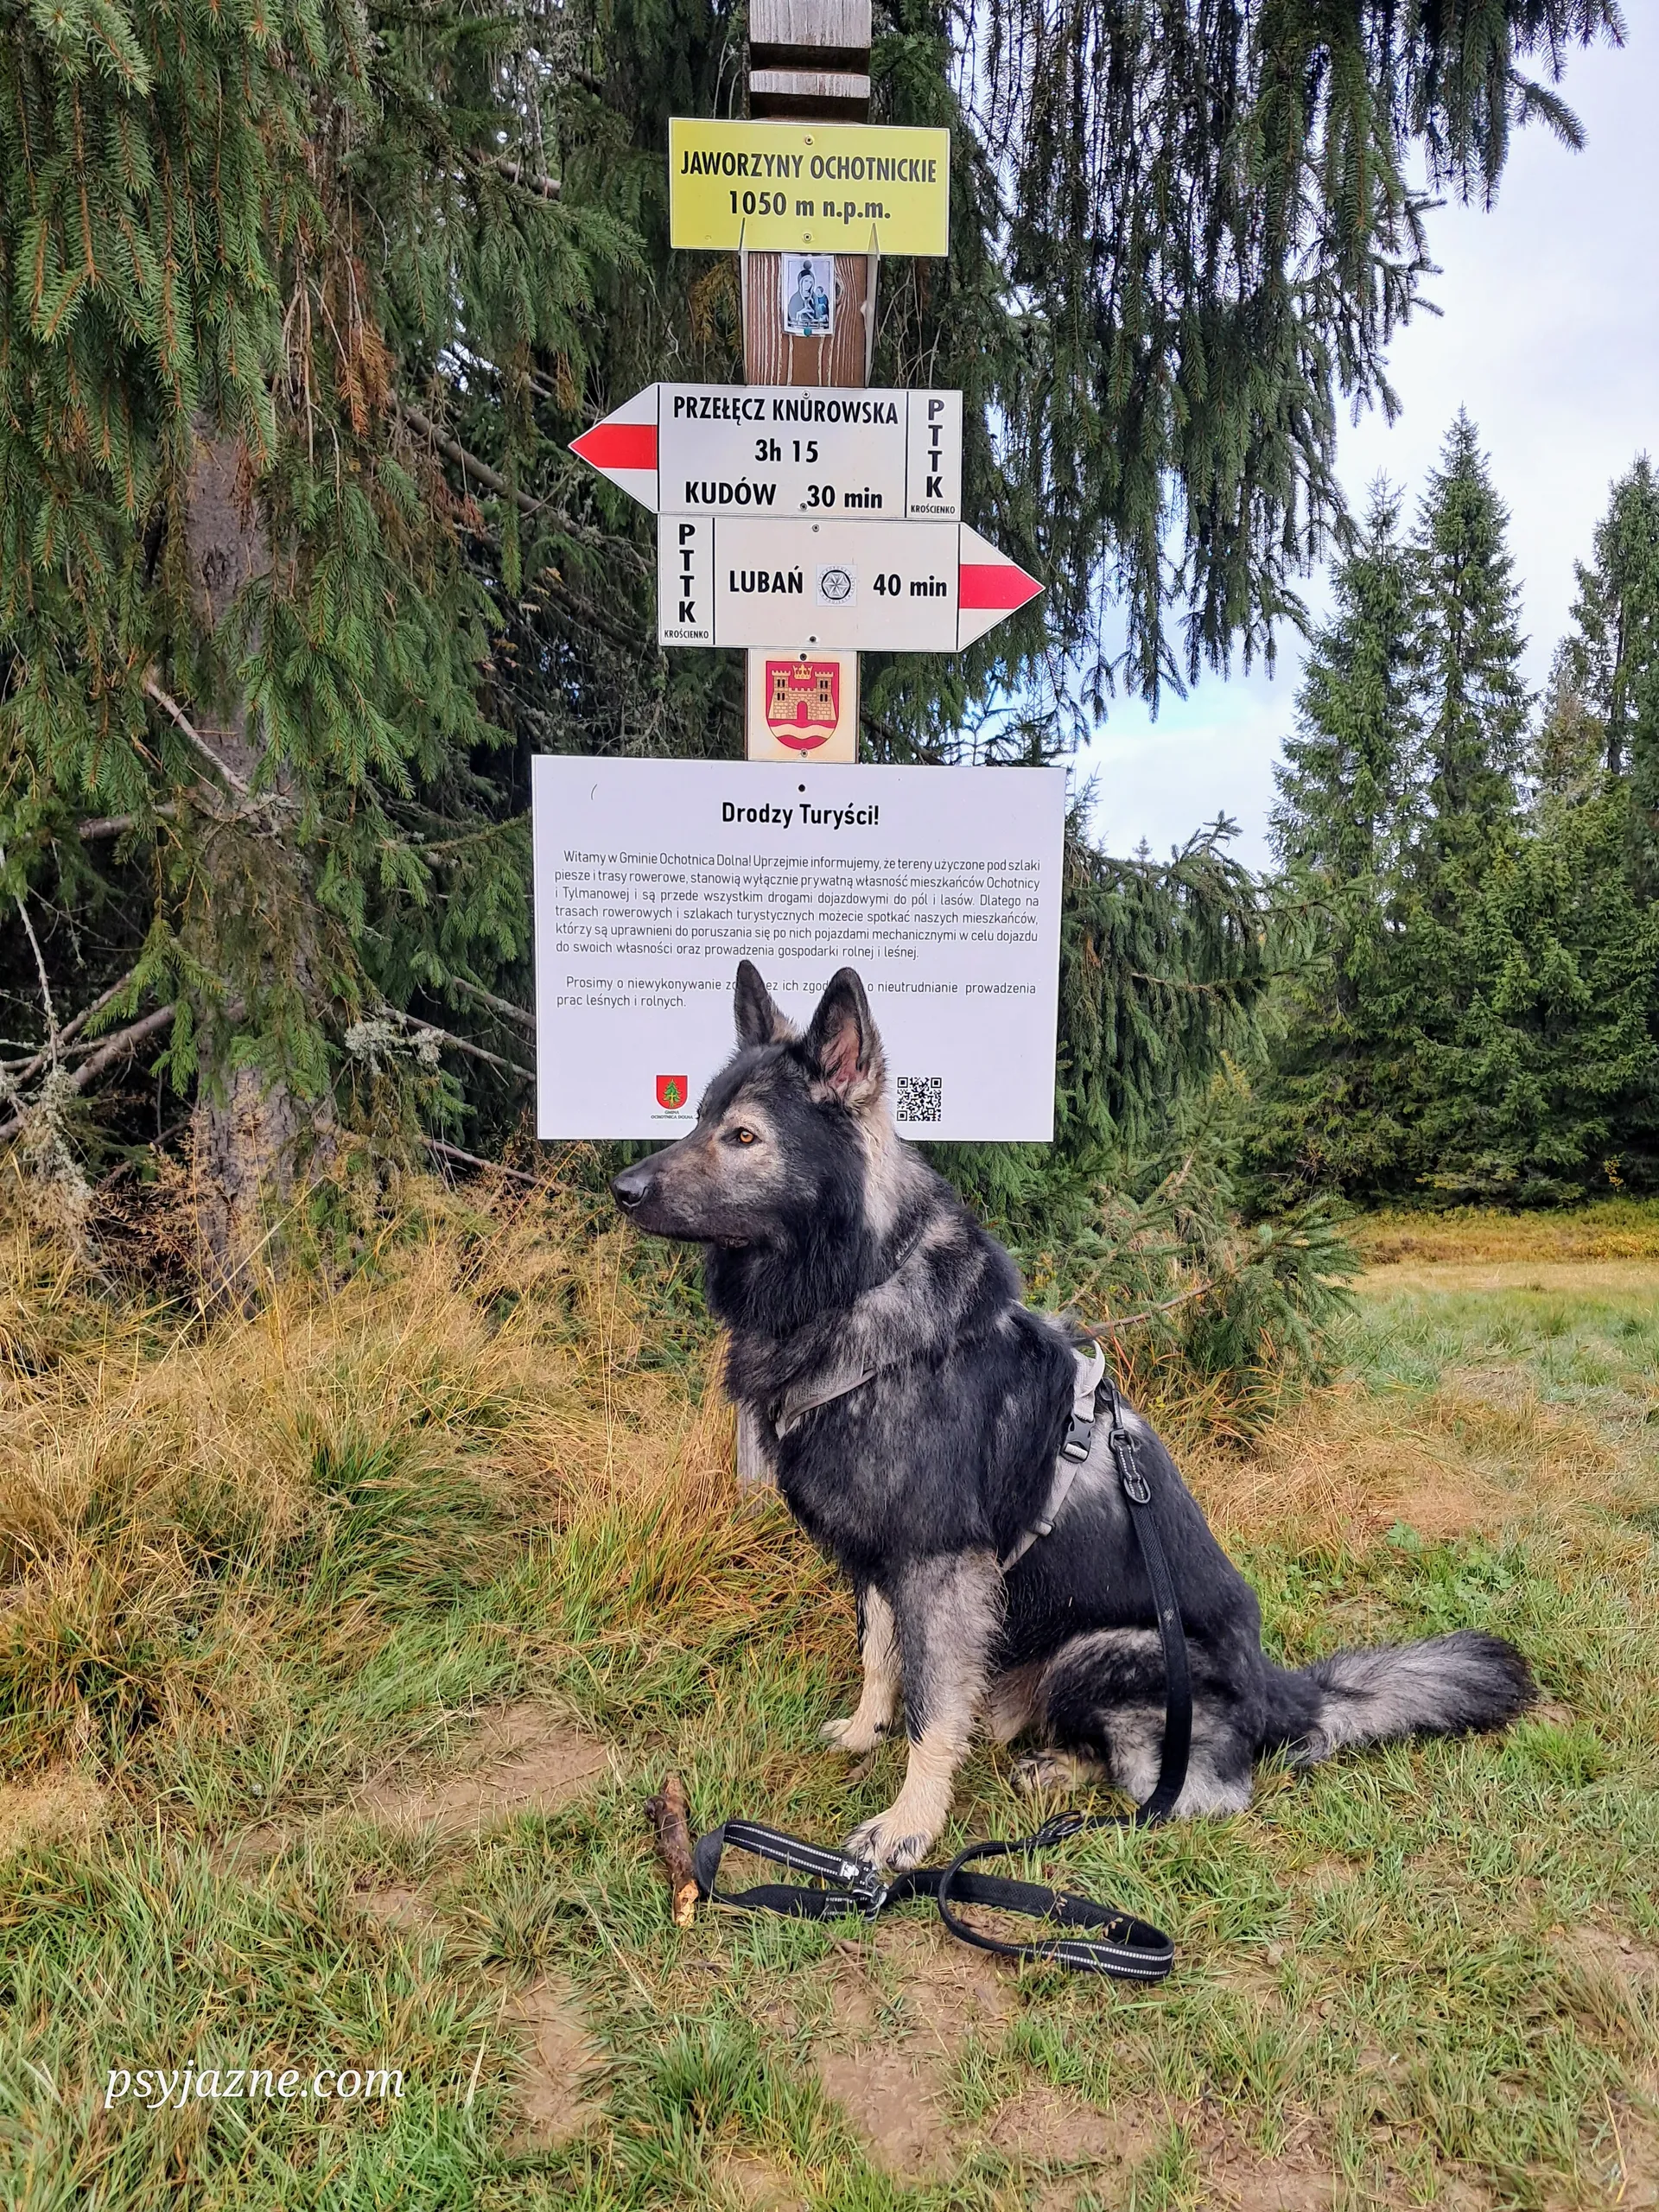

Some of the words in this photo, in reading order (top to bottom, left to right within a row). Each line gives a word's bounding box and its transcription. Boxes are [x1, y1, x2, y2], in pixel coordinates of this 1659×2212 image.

[680, 150, 804, 178] JAWORZYNY
[810, 155, 937, 183] OCHOTNICKIE
[729, 190, 787, 216] 1050
[796, 200, 815, 217] m
[823, 200, 891, 225] n.p.m.
[674, 396, 766, 426] PRZEŁĘCZ
[772, 399, 899, 424] KNUROWSKA
[754, 437, 782, 462] 3h
[792, 440, 818, 463] 15
[685, 476, 777, 505] KUDÓW
[807, 486, 835, 507] 30
[844, 486, 883, 509] min
[910, 505, 956, 514] KROŚCIENKO
[729, 565, 803, 594] LUBAŃ
[873, 573, 901, 597] 40
[910, 575, 947, 597] min
[664, 627, 709, 639] KROŚCIENKO
[722, 801, 794, 830] Drodzy
[798, 802, 879, 830] Turyści!
[563, 849, 607, 867] Witamy
[607, 854, 618, 863] w
[620, 851, 658, 865] Gminie
[659, 852, 715, 866] Ochotnica
[716, 854, 752, 867] Dolna!
[753, 855, 809, 871] Uprzejmie
[810, 855, 881, 872] informujemy,
[883, 860, 896, 869] że
[897, 858, 933, 873] tereny
[934, 861, 985, 874] użyczone
[987, 859, 1007, 874] pod
[1007, 859, 1040, 871] szlaki
[555, 871, 591, 883] piesze
[593, 872, 596, 881] i
[597, 869, 627, 885] trasy
[629, 873, 689, 885] rowerowe,
[690, 872, 741, 887] stanowią
[742, 873, 798, 888] wyłącznie
[800, 874, 854, 890] prywatną
[855, 874, 908, 887] własność
[910, 874, 985, 888] mieszkańców
[986, 876, 1040, 893] Ochotnicy
[555, 889, 558, 899] i
[562, 886, 630, 903] Tylmanowej
[634, 887, 638, 900] i
[642, 891, 656, 904] są
[660, 889, 699, 904] przede
[703, 890, 763, 905] wszystkim
[767, 891, 813, 906] drogami
[817, 892, 889, 907] dojazdowymi
[893, 893, 907, 905] do
[911, 892, 928, 908] pól
[932, 896, 936, 906] i
[940, 893, 974, 906] lasów.
[980, 893, 1021, 909] Dlatego
[1026, 897, 1039, 906] na
[555, 905, 599, 917] trasach
[602, 906, 672, 922] rowerowych
[677, 906, 679, 918] i
[683, 907, 733, 920] szlakach
[736, 909, 815, 925] turystycznych
[818, 910, 864, 922] możecie
[867, 909, 911, 925] spotkać
[913, 912, 959, 926] naszych
[963, 911, 1039, 925] mieszkańców,
[556, 921, 593, 938] którzy
[594, 925, 608, 938] są
[610, 924, 672, 938] uprawnieni
[675, 925, 689, 937] do
[691, 925, 753, 940] poruszania
[754, 929, 771, 941] się
[773, 929, 786, 941] po
[789, 927, 812, 939] nich
[814, 927, 869, 942] pojazdami
[872, 928, 957, 944] mechanicznymi
[958, 931, 969, 941] w
[970, 929, 995, 942] celu
[996, 929, 1038, 944] dojazdu
[556, 940, 569, 952] do
[573, 941, 613, 953] swoich
[615, 940, 672, 955] własności
[676, 945, 701, 955] oraz
[704, 944, 774, 958] prowadzenia
[778, 944, 839, 959] gospodarki
[842, 945, 874, 961] rolnej
[877, 948, 880, 957] i
[884, 944, 919, 961] leśnej.
[566, 976, 613, 992] Prosimy
[616, 979, 624, 988] o
[627, 977, 721, 993] niewykonywanie
[782, 979, 799, 991] ich
[803, 981, 831, 994] zgod
[867, 982, 874, 992] o
[877, 981, 958, 993] nieutrudnianie
[965, 982, 1036, 996] prowadzenia
[556, 995, 583, 1008] prac
[586, 993, 631, 1009] leśnych
[634, 997, 637, 1007] i
[640, 995, 687, 1010] rolnych.
